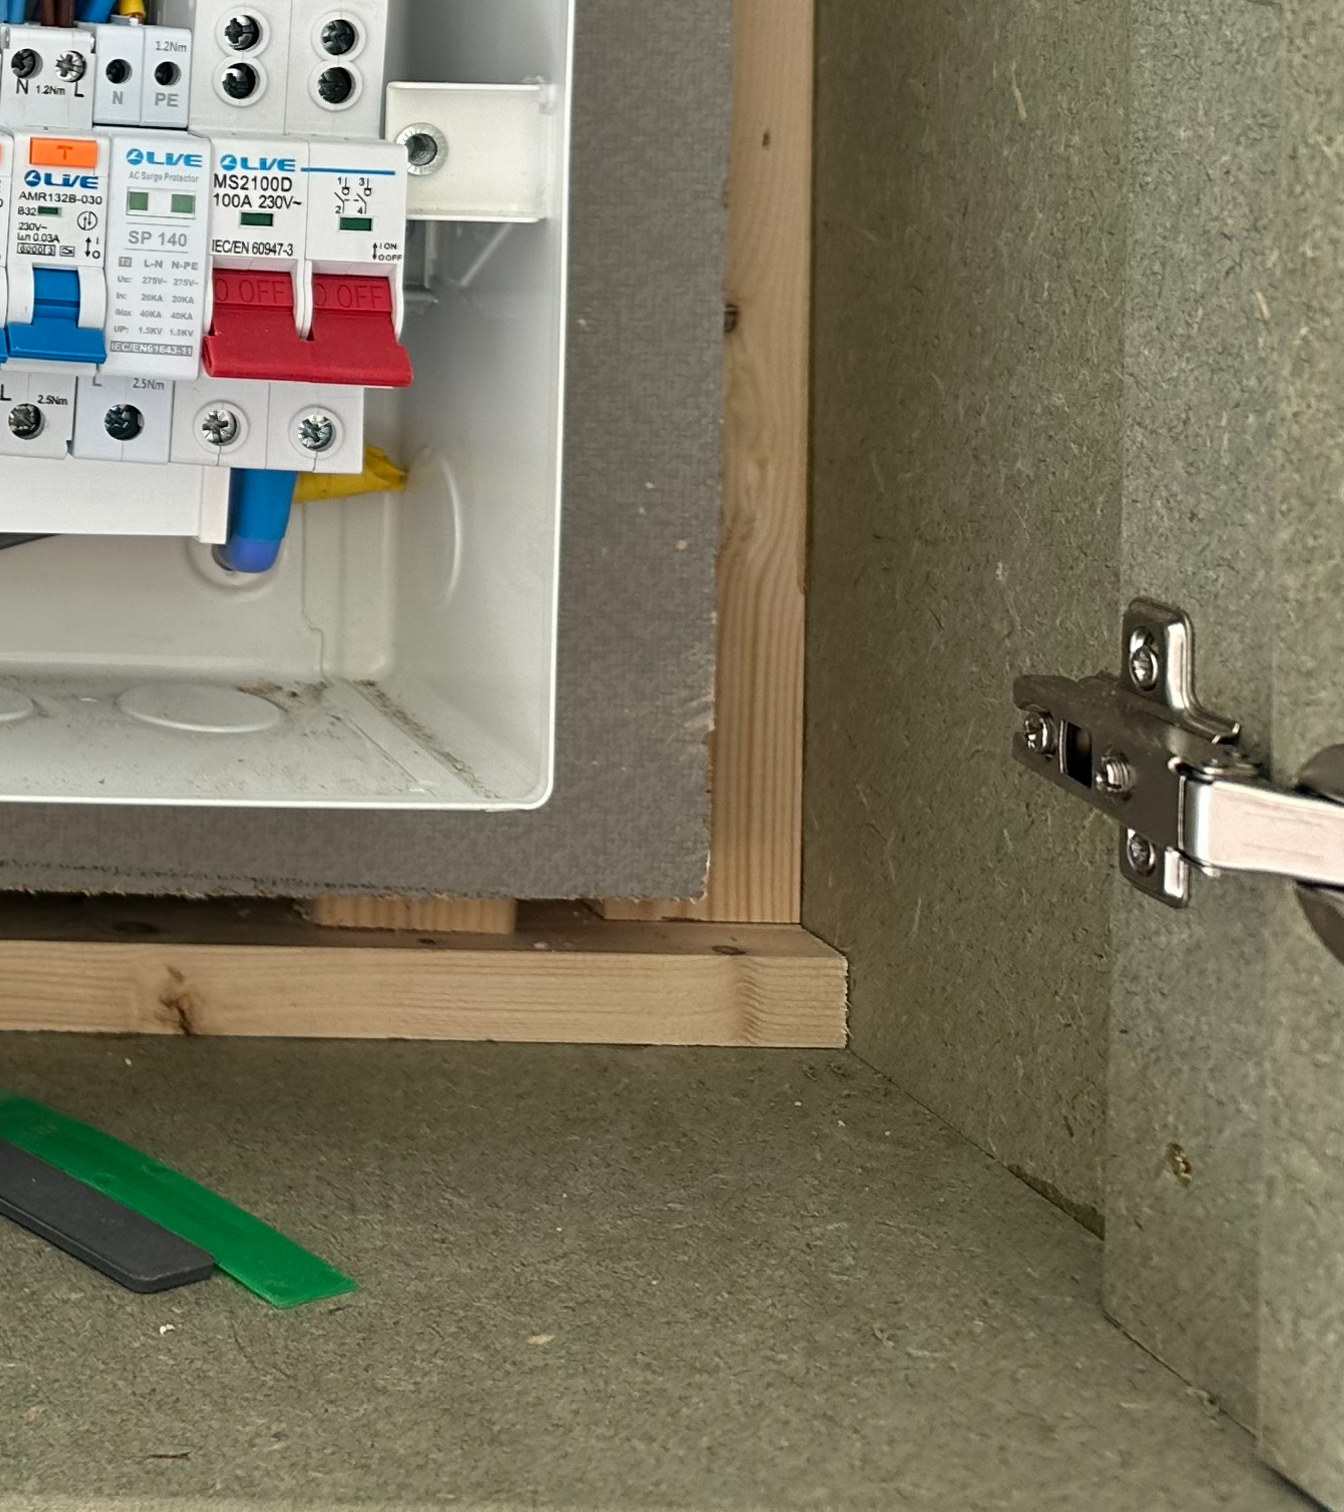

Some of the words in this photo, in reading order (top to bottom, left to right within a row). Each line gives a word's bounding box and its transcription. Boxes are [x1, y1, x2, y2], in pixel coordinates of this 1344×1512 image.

[112, 91, 123, 104] N
[155, 92, 179, 107] PE
[213, 173, 293, 192] MS2100D
[212, 194, 252, 208] 100A
[128, 230, 152, 244] SP
[158, 232, 187, 247] 140
[212, 239, 249, 254] IEC/EN
[251, 242, 294, 256] 60947-3
[144, 259, 163, 268] L-N
[171, 260, 199, 270] N-PE
[238, 279, 285, 303] OFF
[337, 284, 383, 309] OFF
